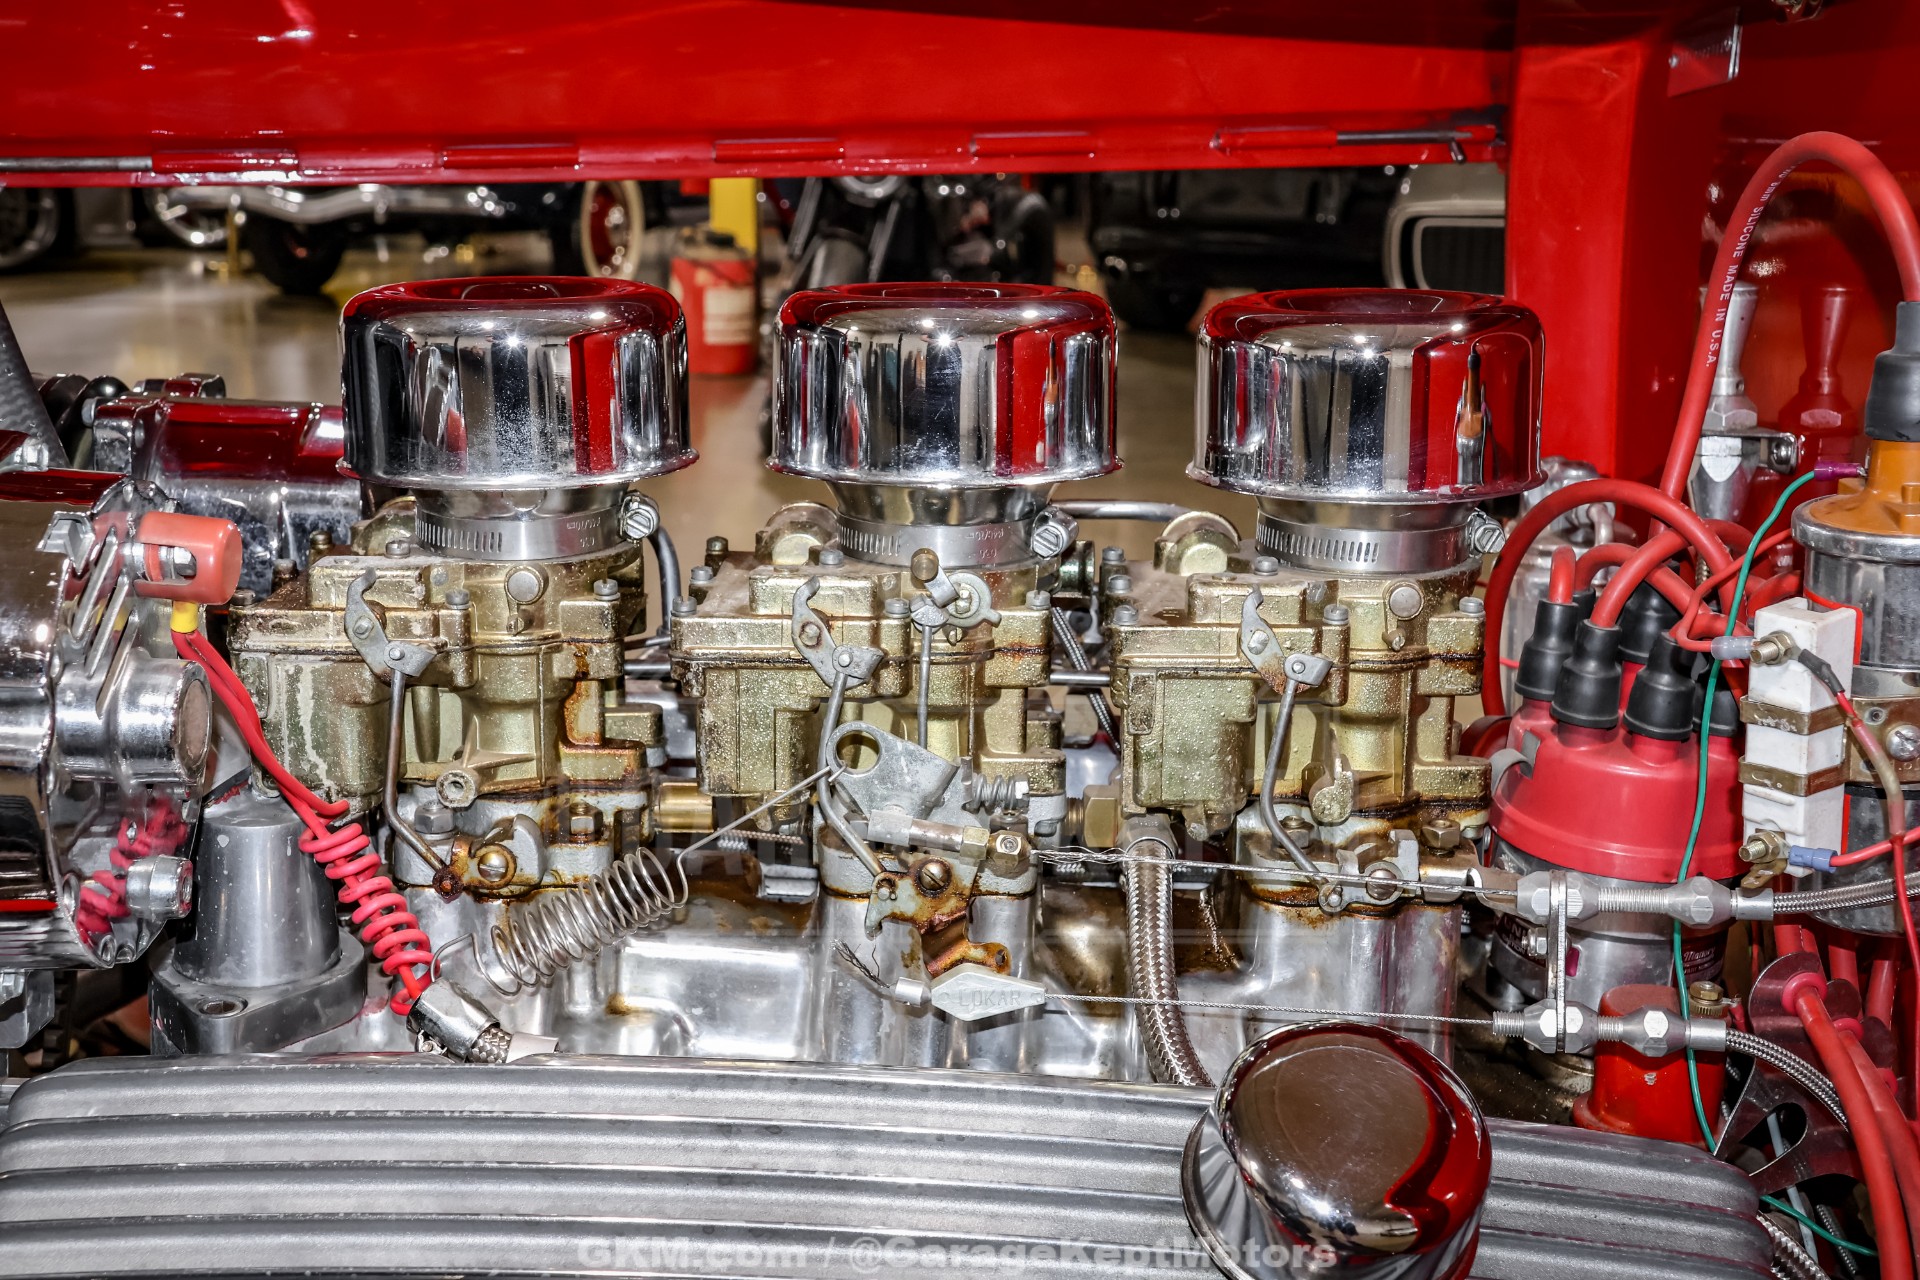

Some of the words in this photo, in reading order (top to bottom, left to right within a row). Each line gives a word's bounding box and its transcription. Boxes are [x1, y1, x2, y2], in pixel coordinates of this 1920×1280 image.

[1733, 206, 1763, 258] SILICONE
[1720, 264, 1738, 300] MADE
[1715, 308, 1726, 322] IN
[1706, 329, 1722, 367] U.S.A.
